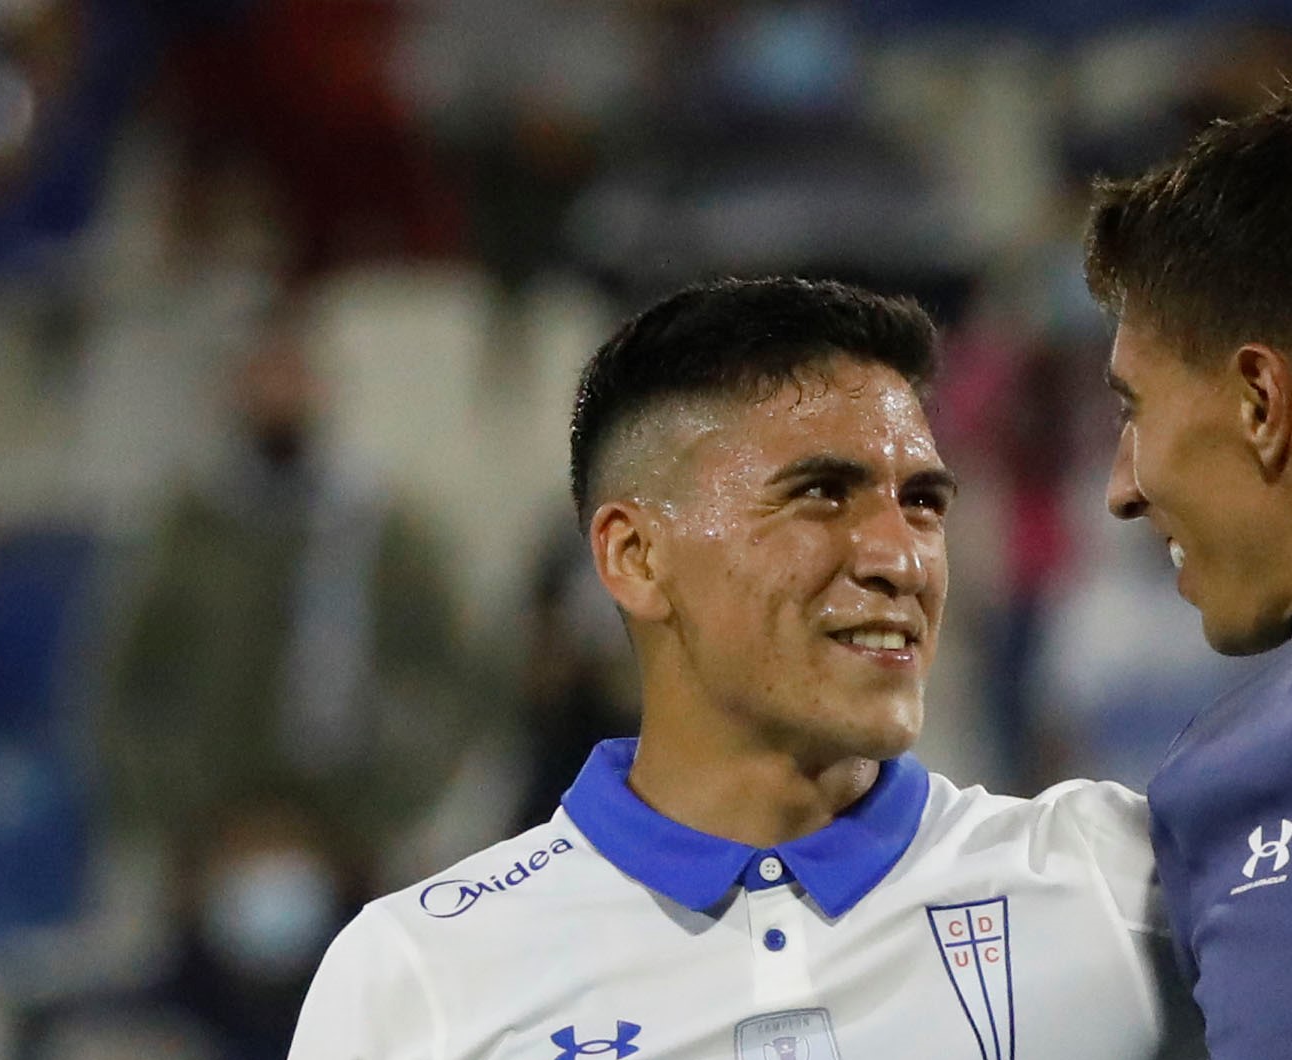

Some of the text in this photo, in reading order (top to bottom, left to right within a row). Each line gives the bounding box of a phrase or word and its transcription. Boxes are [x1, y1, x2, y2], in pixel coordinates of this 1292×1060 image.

[419, 838, 574, 918] Midea
[948, 916, 993, 937] C D
[954, 947, 1000, 967] U C
